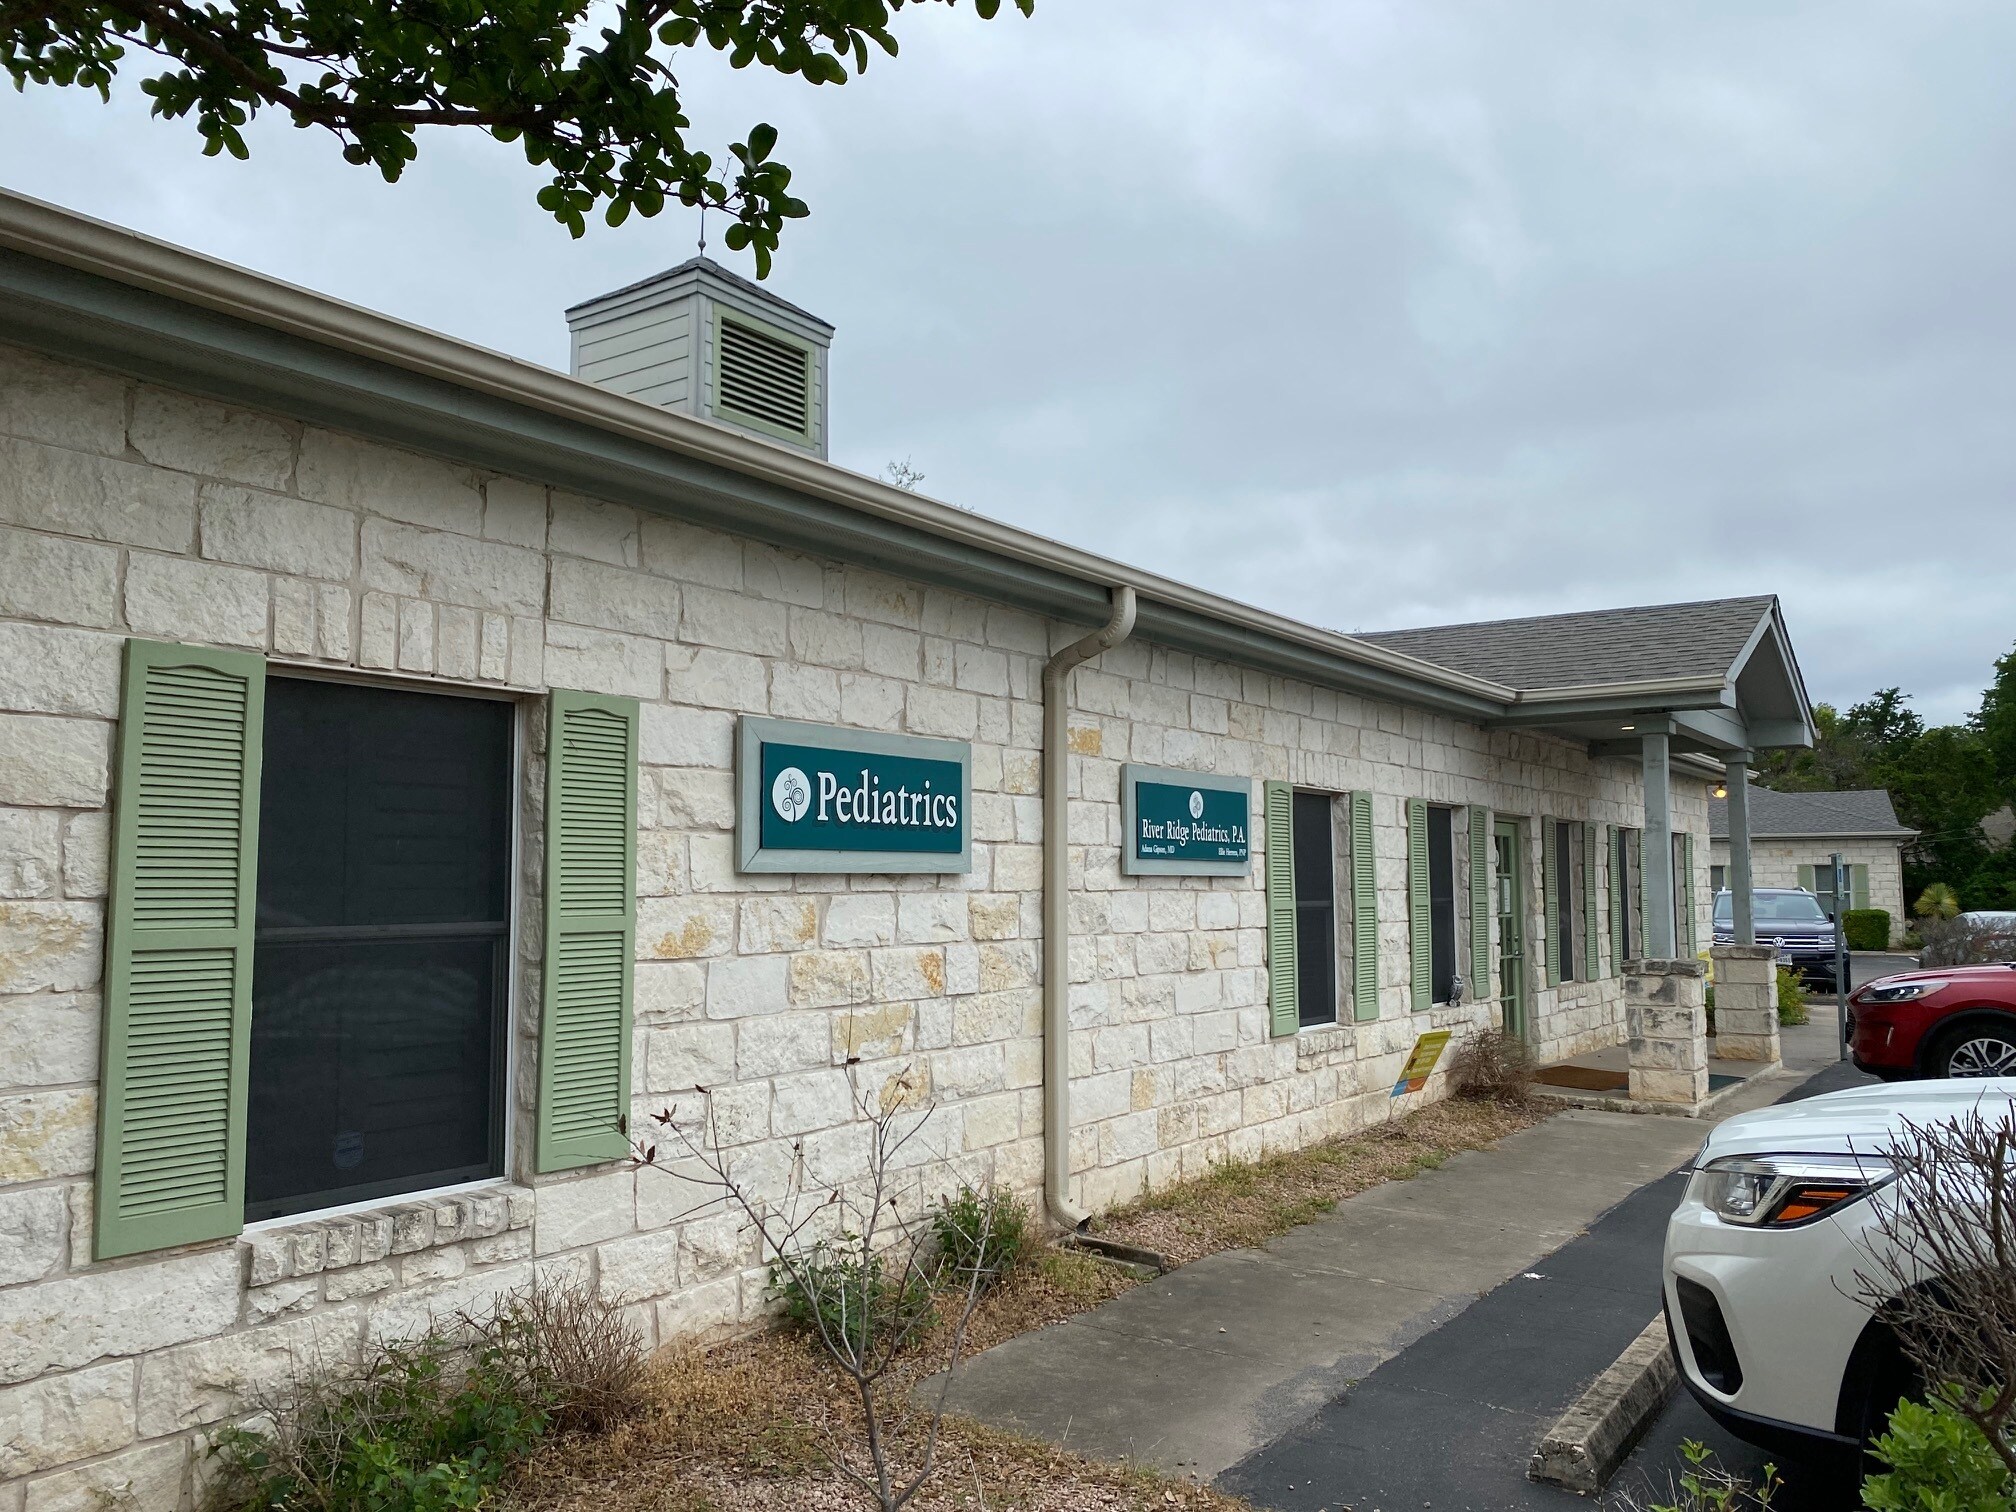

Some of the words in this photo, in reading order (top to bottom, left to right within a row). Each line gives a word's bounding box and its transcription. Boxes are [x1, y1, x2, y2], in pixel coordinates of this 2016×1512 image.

[817, 768, 958, 828] Pediatrics
[1142, 819, 1164, 839] River
[1167, 819, 1189, 846] Ridge
[1192, 821, 1230, 843] Pediatrics,
[1167, 845, 1176, 854] MD
